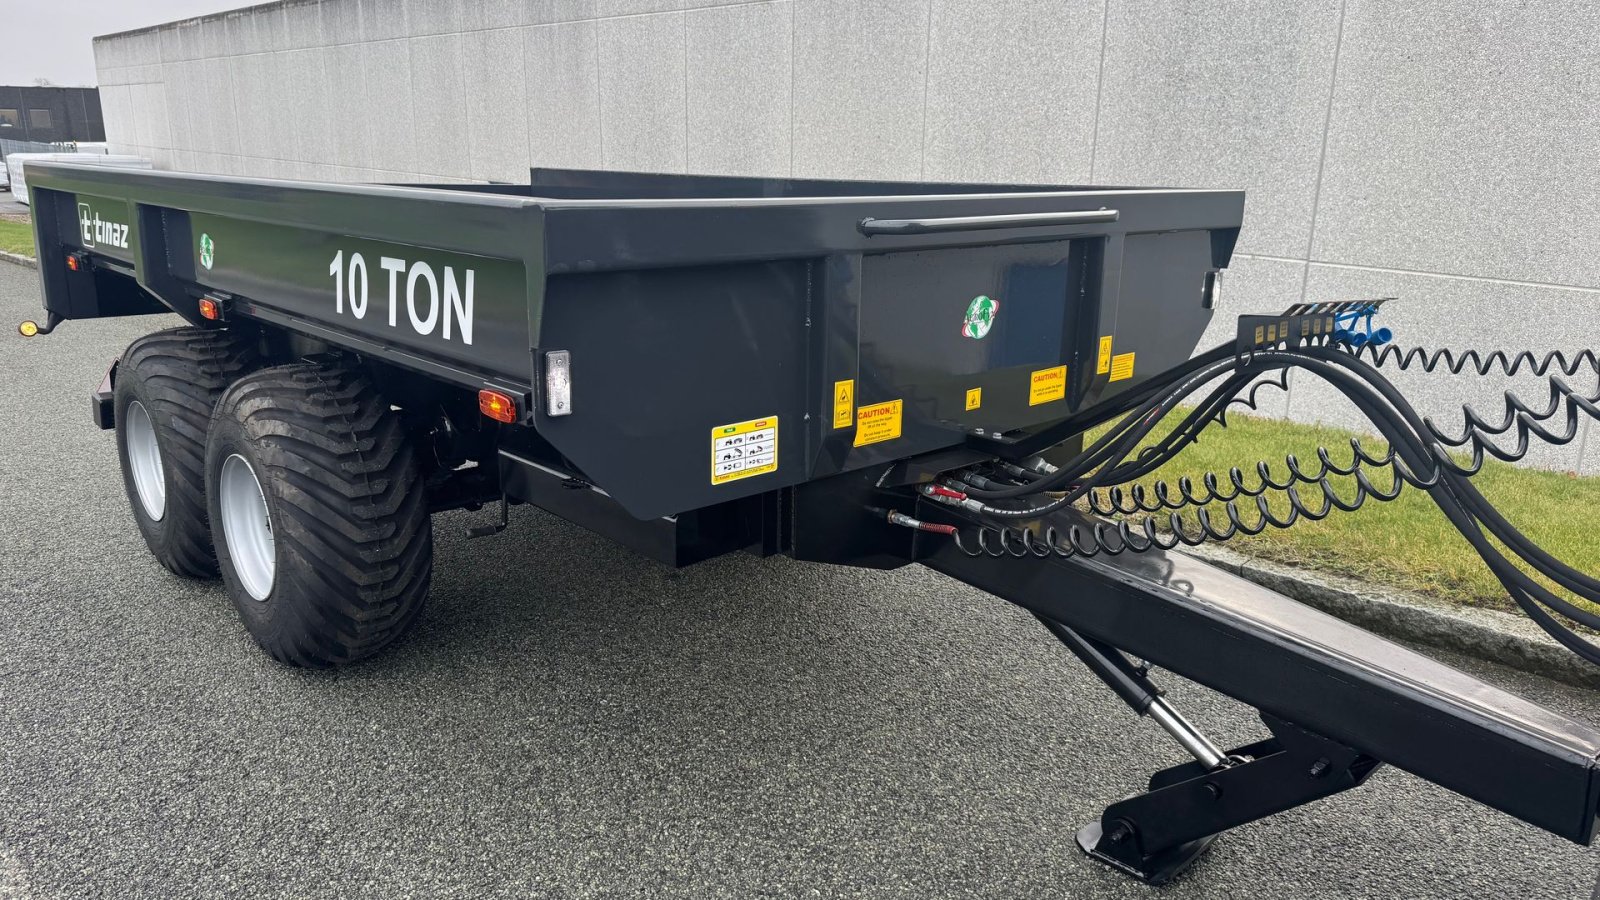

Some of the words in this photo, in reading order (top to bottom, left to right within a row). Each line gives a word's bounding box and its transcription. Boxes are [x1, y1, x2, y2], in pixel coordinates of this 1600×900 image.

[330, 250, 368, 320] 10
[380, 256, 474, 345] TON
[1033, 372, 1058, 383] CAUTION
[858, 407, 890, 419] CAUTION
